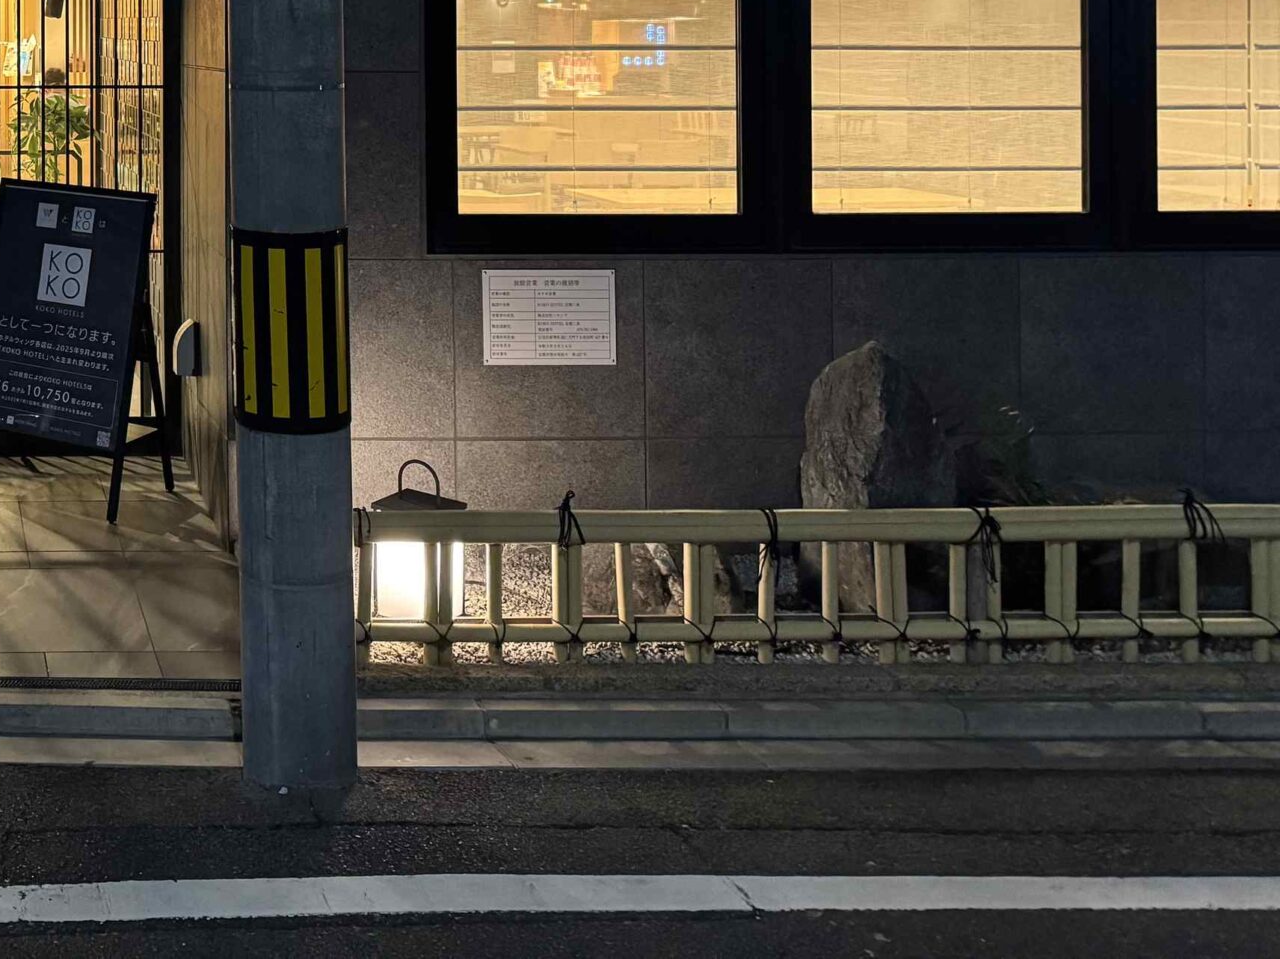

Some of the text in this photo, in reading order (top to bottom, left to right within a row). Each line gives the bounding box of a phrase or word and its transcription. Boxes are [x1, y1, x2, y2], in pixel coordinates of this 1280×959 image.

[48, 249, 84, 275] KO
[45, 274, 81, 299] KO
[35, 304, 56, 314] KOKO
[0, 314, 116, 346] として一つになります。
[26, 384, 70, 403] 10,750
